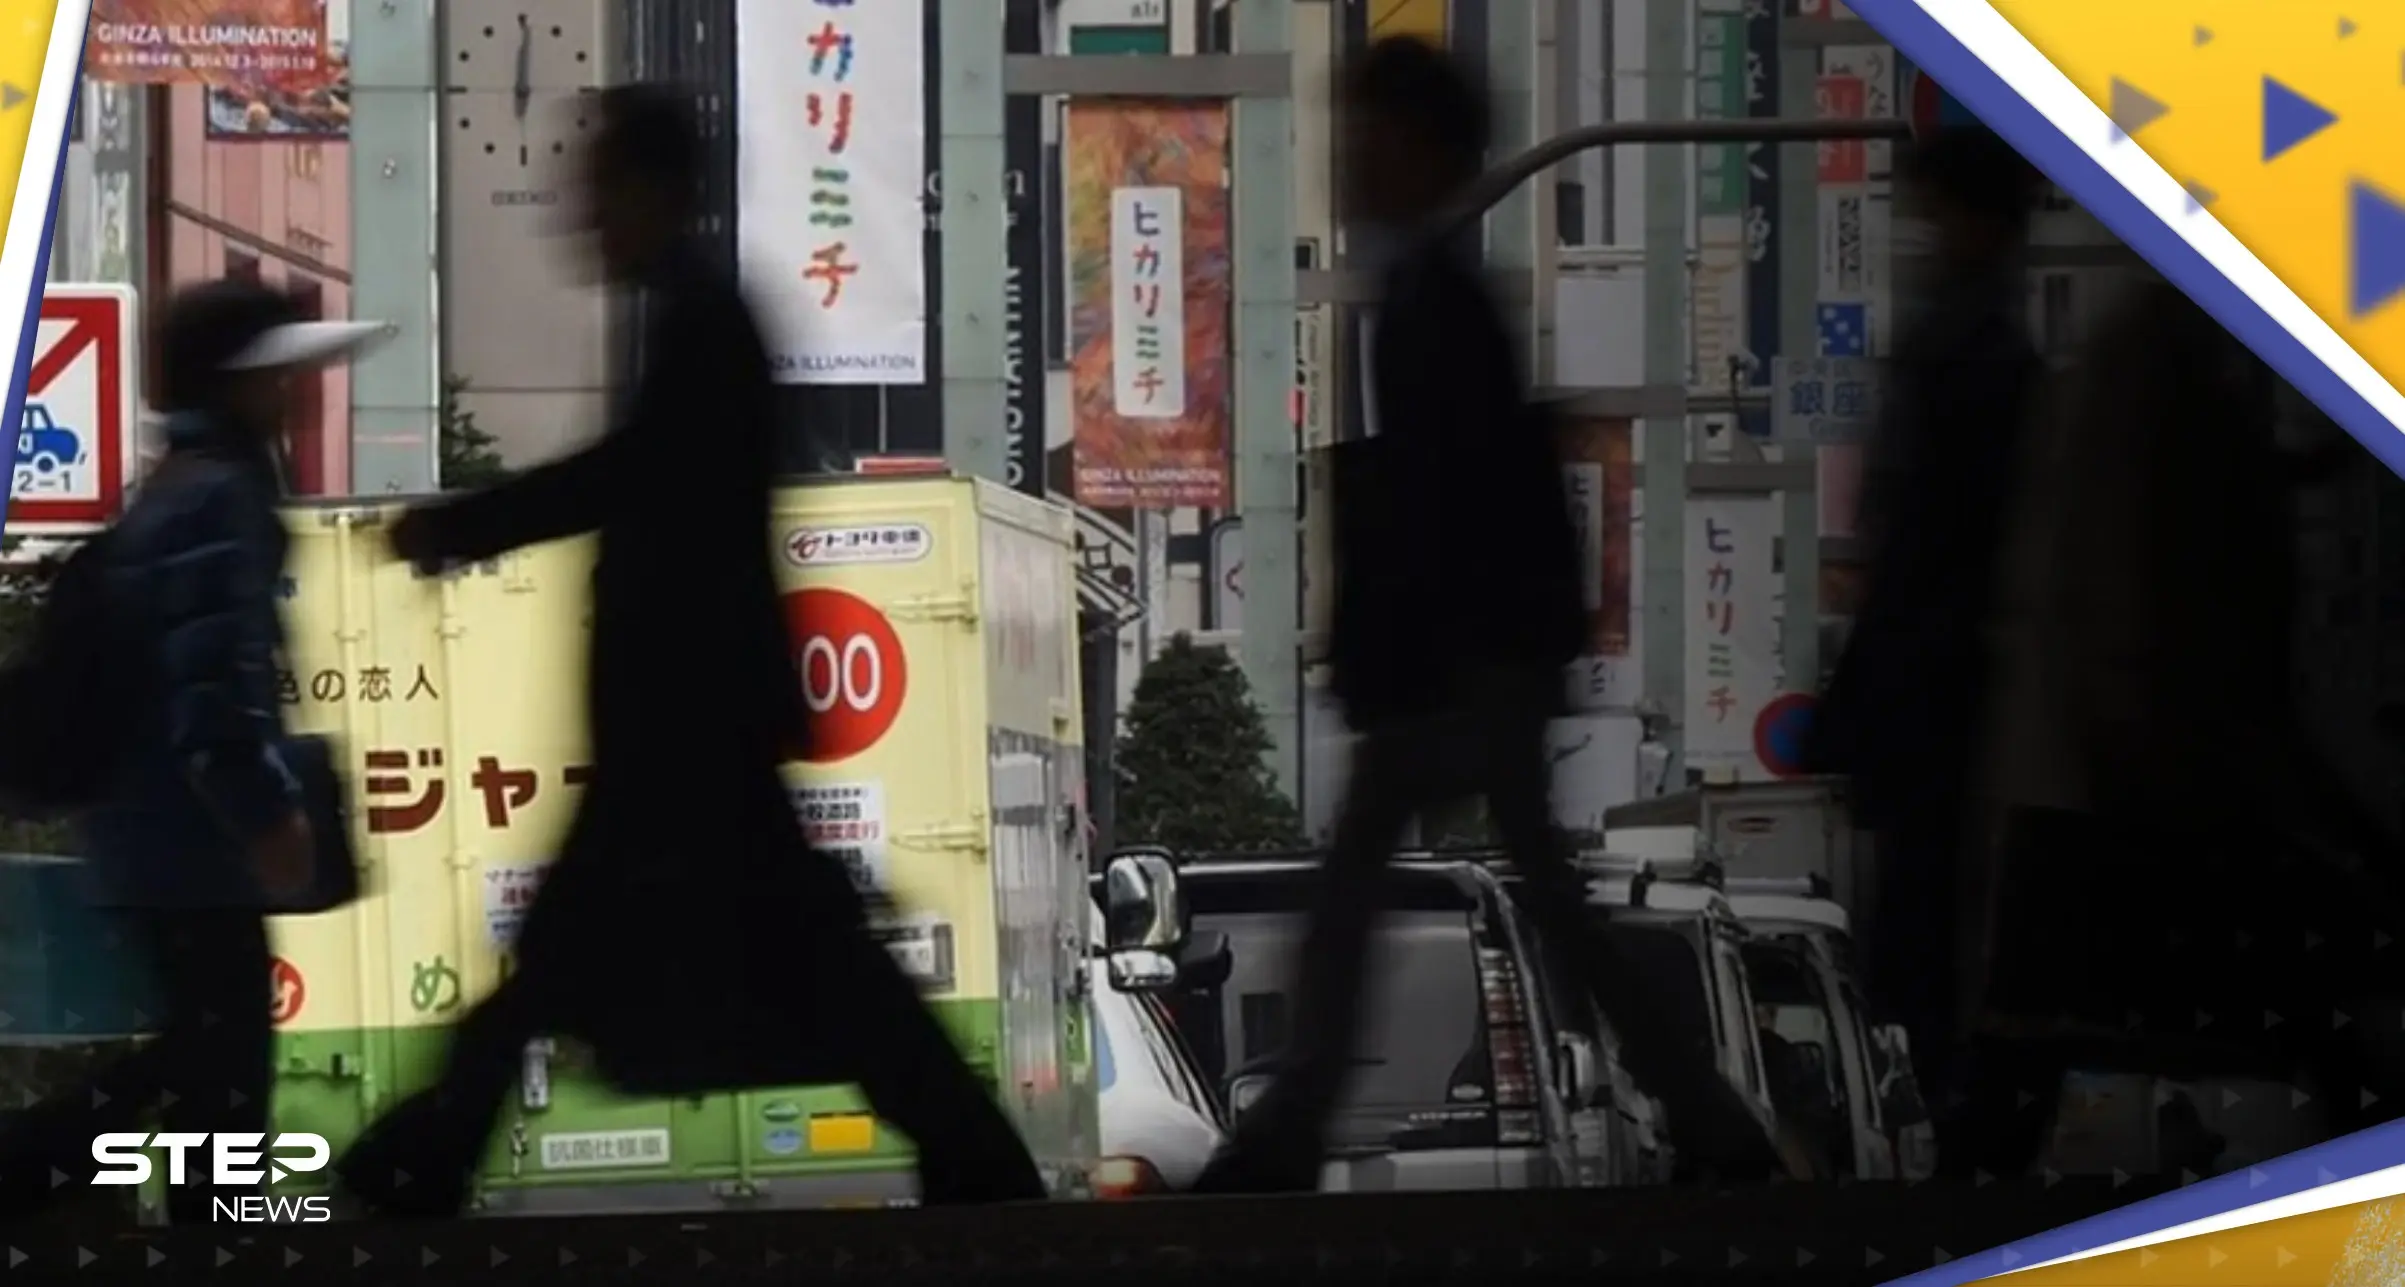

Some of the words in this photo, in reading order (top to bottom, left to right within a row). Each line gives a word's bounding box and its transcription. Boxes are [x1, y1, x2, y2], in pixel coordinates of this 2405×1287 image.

[98, 24, 162, 44] GINZA
[167, 25, 317, 47] ILLUMINATION
[803, 0, 857, 308] カリミチ
[801, 353, 916, 371] ILLUMINATION
[1132, 201, 1164, 404] ヒカリミチ
[1706, 517, 1737, 724] ヒカリミチ
[410, 955, 460, 1012] め
